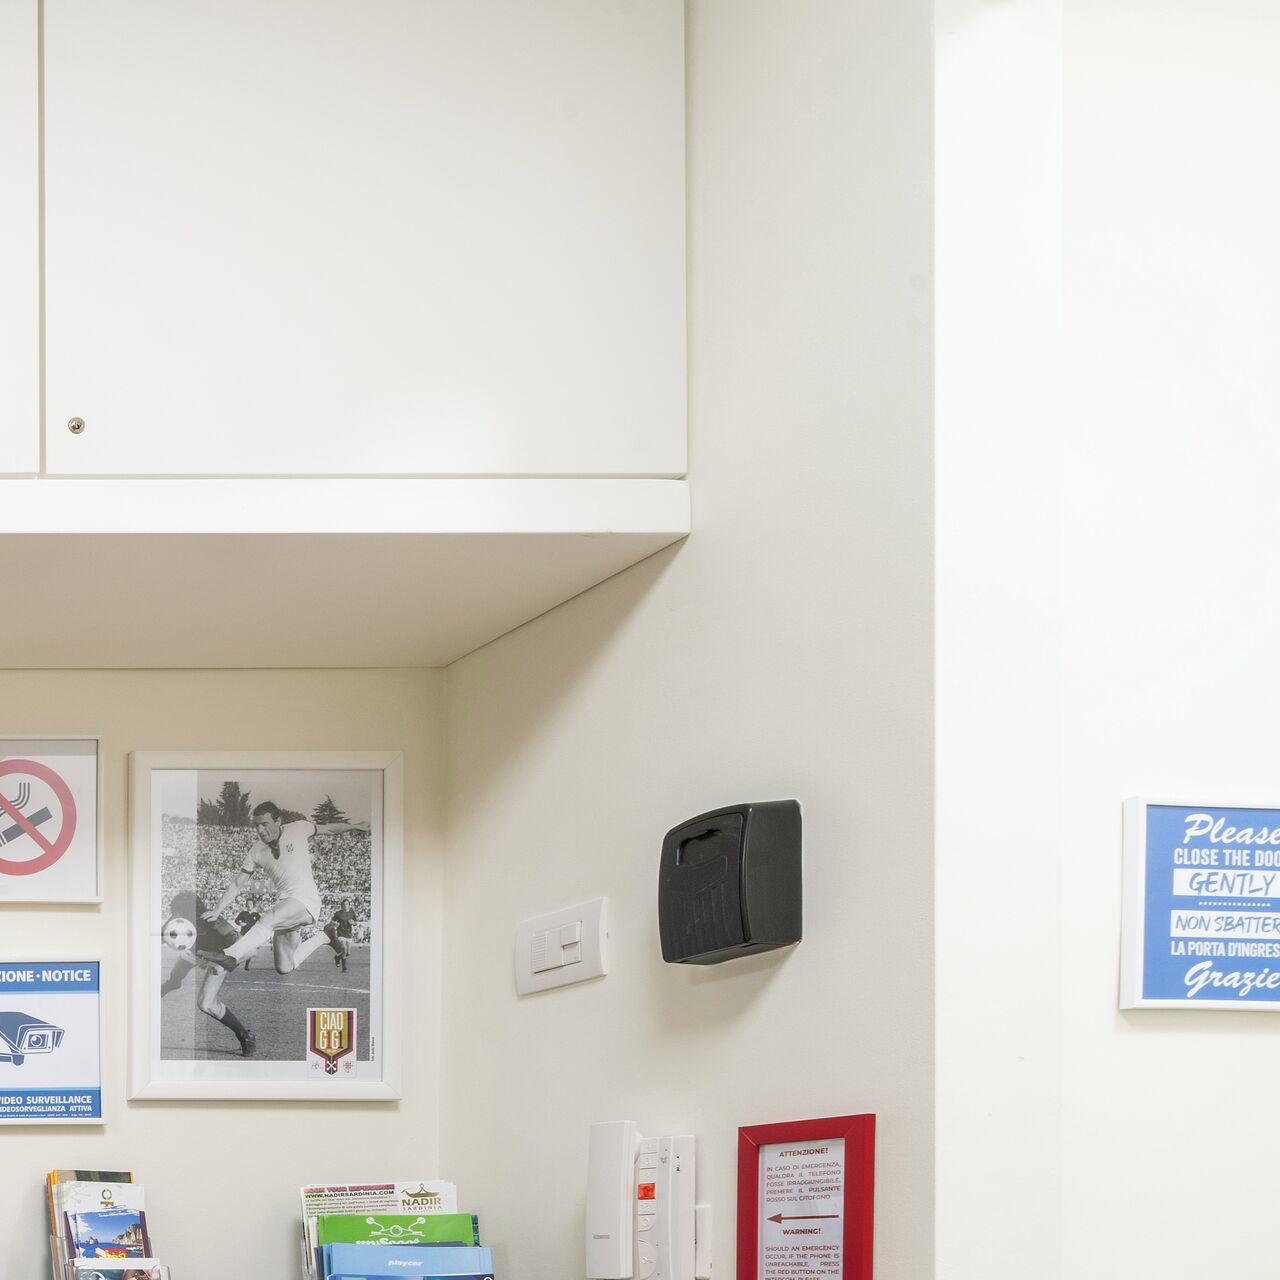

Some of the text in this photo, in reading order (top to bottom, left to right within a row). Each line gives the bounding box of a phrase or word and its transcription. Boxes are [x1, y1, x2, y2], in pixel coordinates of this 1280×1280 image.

[1183, 813, 1280, 845] Please
[1173, 847, 1220, 866] CLOSE
[1223, 849, 1251, 866] THE
[1189, 872, 1277, 897] GENTLY
[1175, 915, 1212, 932] NON
[1171, 941, 1186, 956] LA
[1187, 941, 1226, 957] PORTA
[41, 969, 92, 982] NOTICE
[1184, 960, 1280, 998] Grazie
[320, 1012, 344, 1030] CIAO
[26, 1095, 93, 1105] SURVEILLANCE
[69, 1104, 93, 1112] ATTIVA
[779, 1147, 829, 1158] ATTENZIONE!
[808, 1169, 841, 1177] TELEFONO
[305, 1190, 395, 1199] WWW.NADIRSARDINIA.COM
[808, 1185, 841, 1193] PULSANTE
[402, 1198, 441, 1206] NADIR
[783, 1228, 822, 1236] WARNING!
